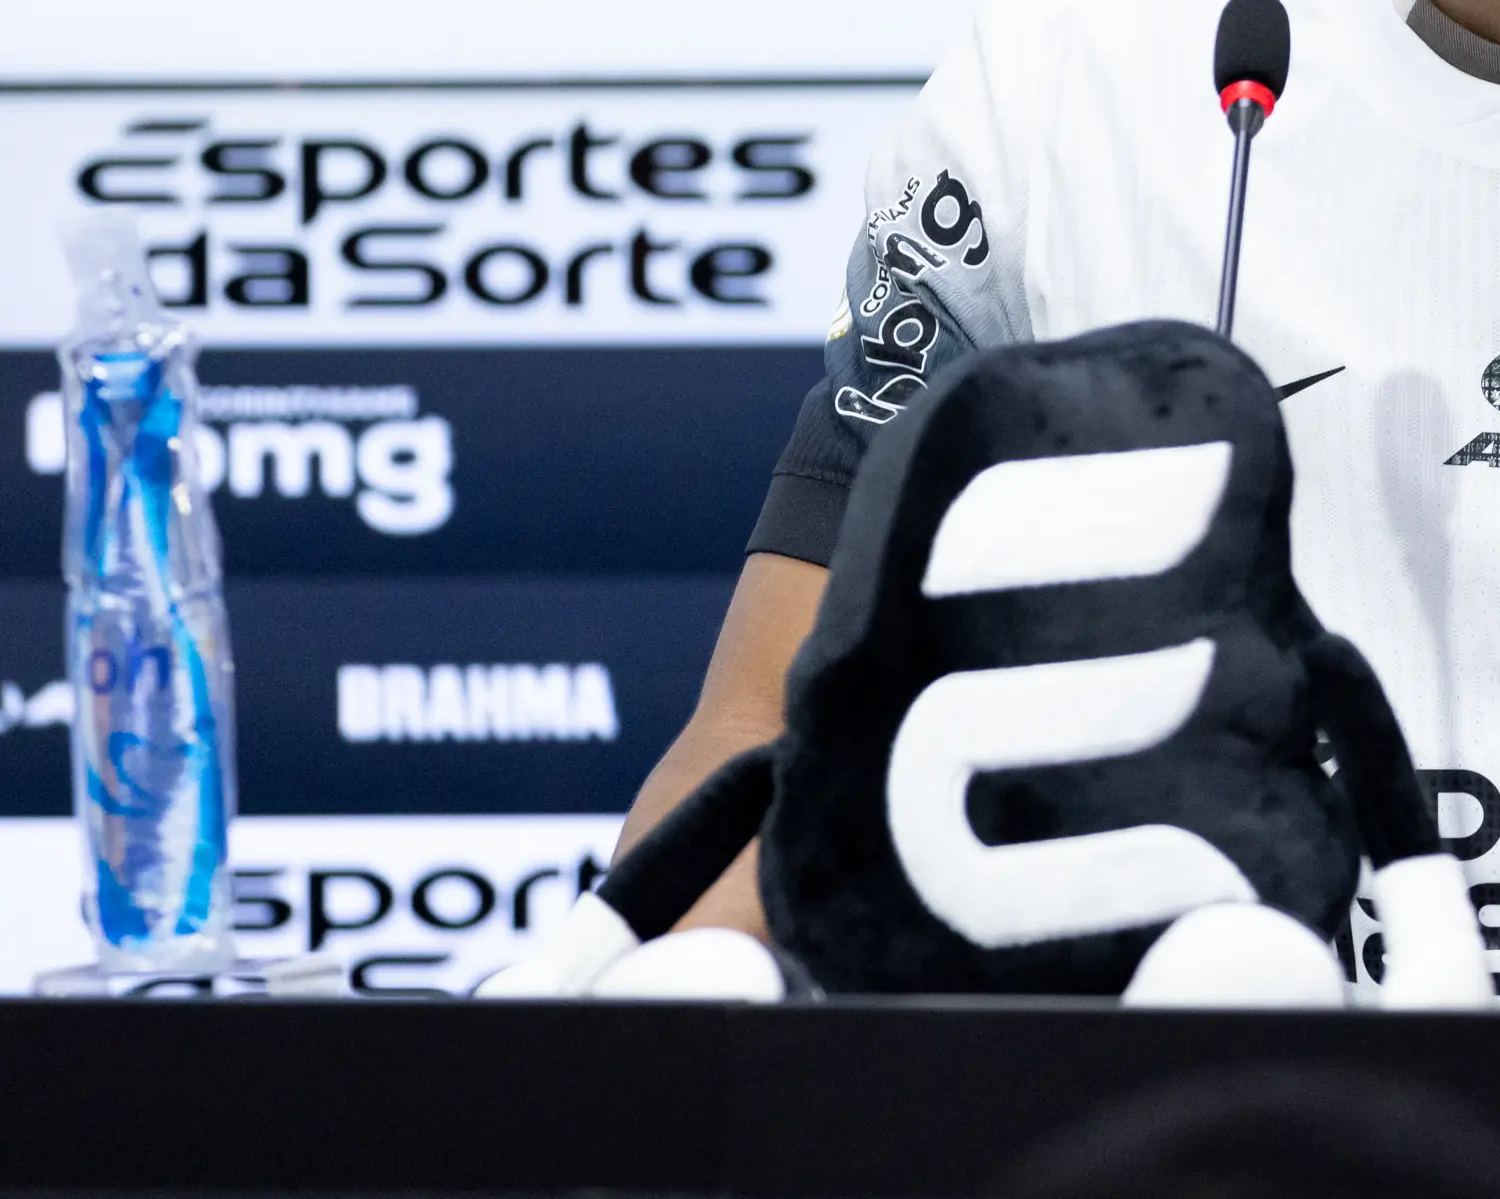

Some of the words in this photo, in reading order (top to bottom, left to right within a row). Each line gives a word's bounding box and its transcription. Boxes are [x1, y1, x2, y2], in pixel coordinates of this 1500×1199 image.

[75, 118, 819, 226] Esportes
[148, 228, 310, 309] da
[339, 223, 776, 310] Sorte
[336, 662, 619, 741] BRAHMA
